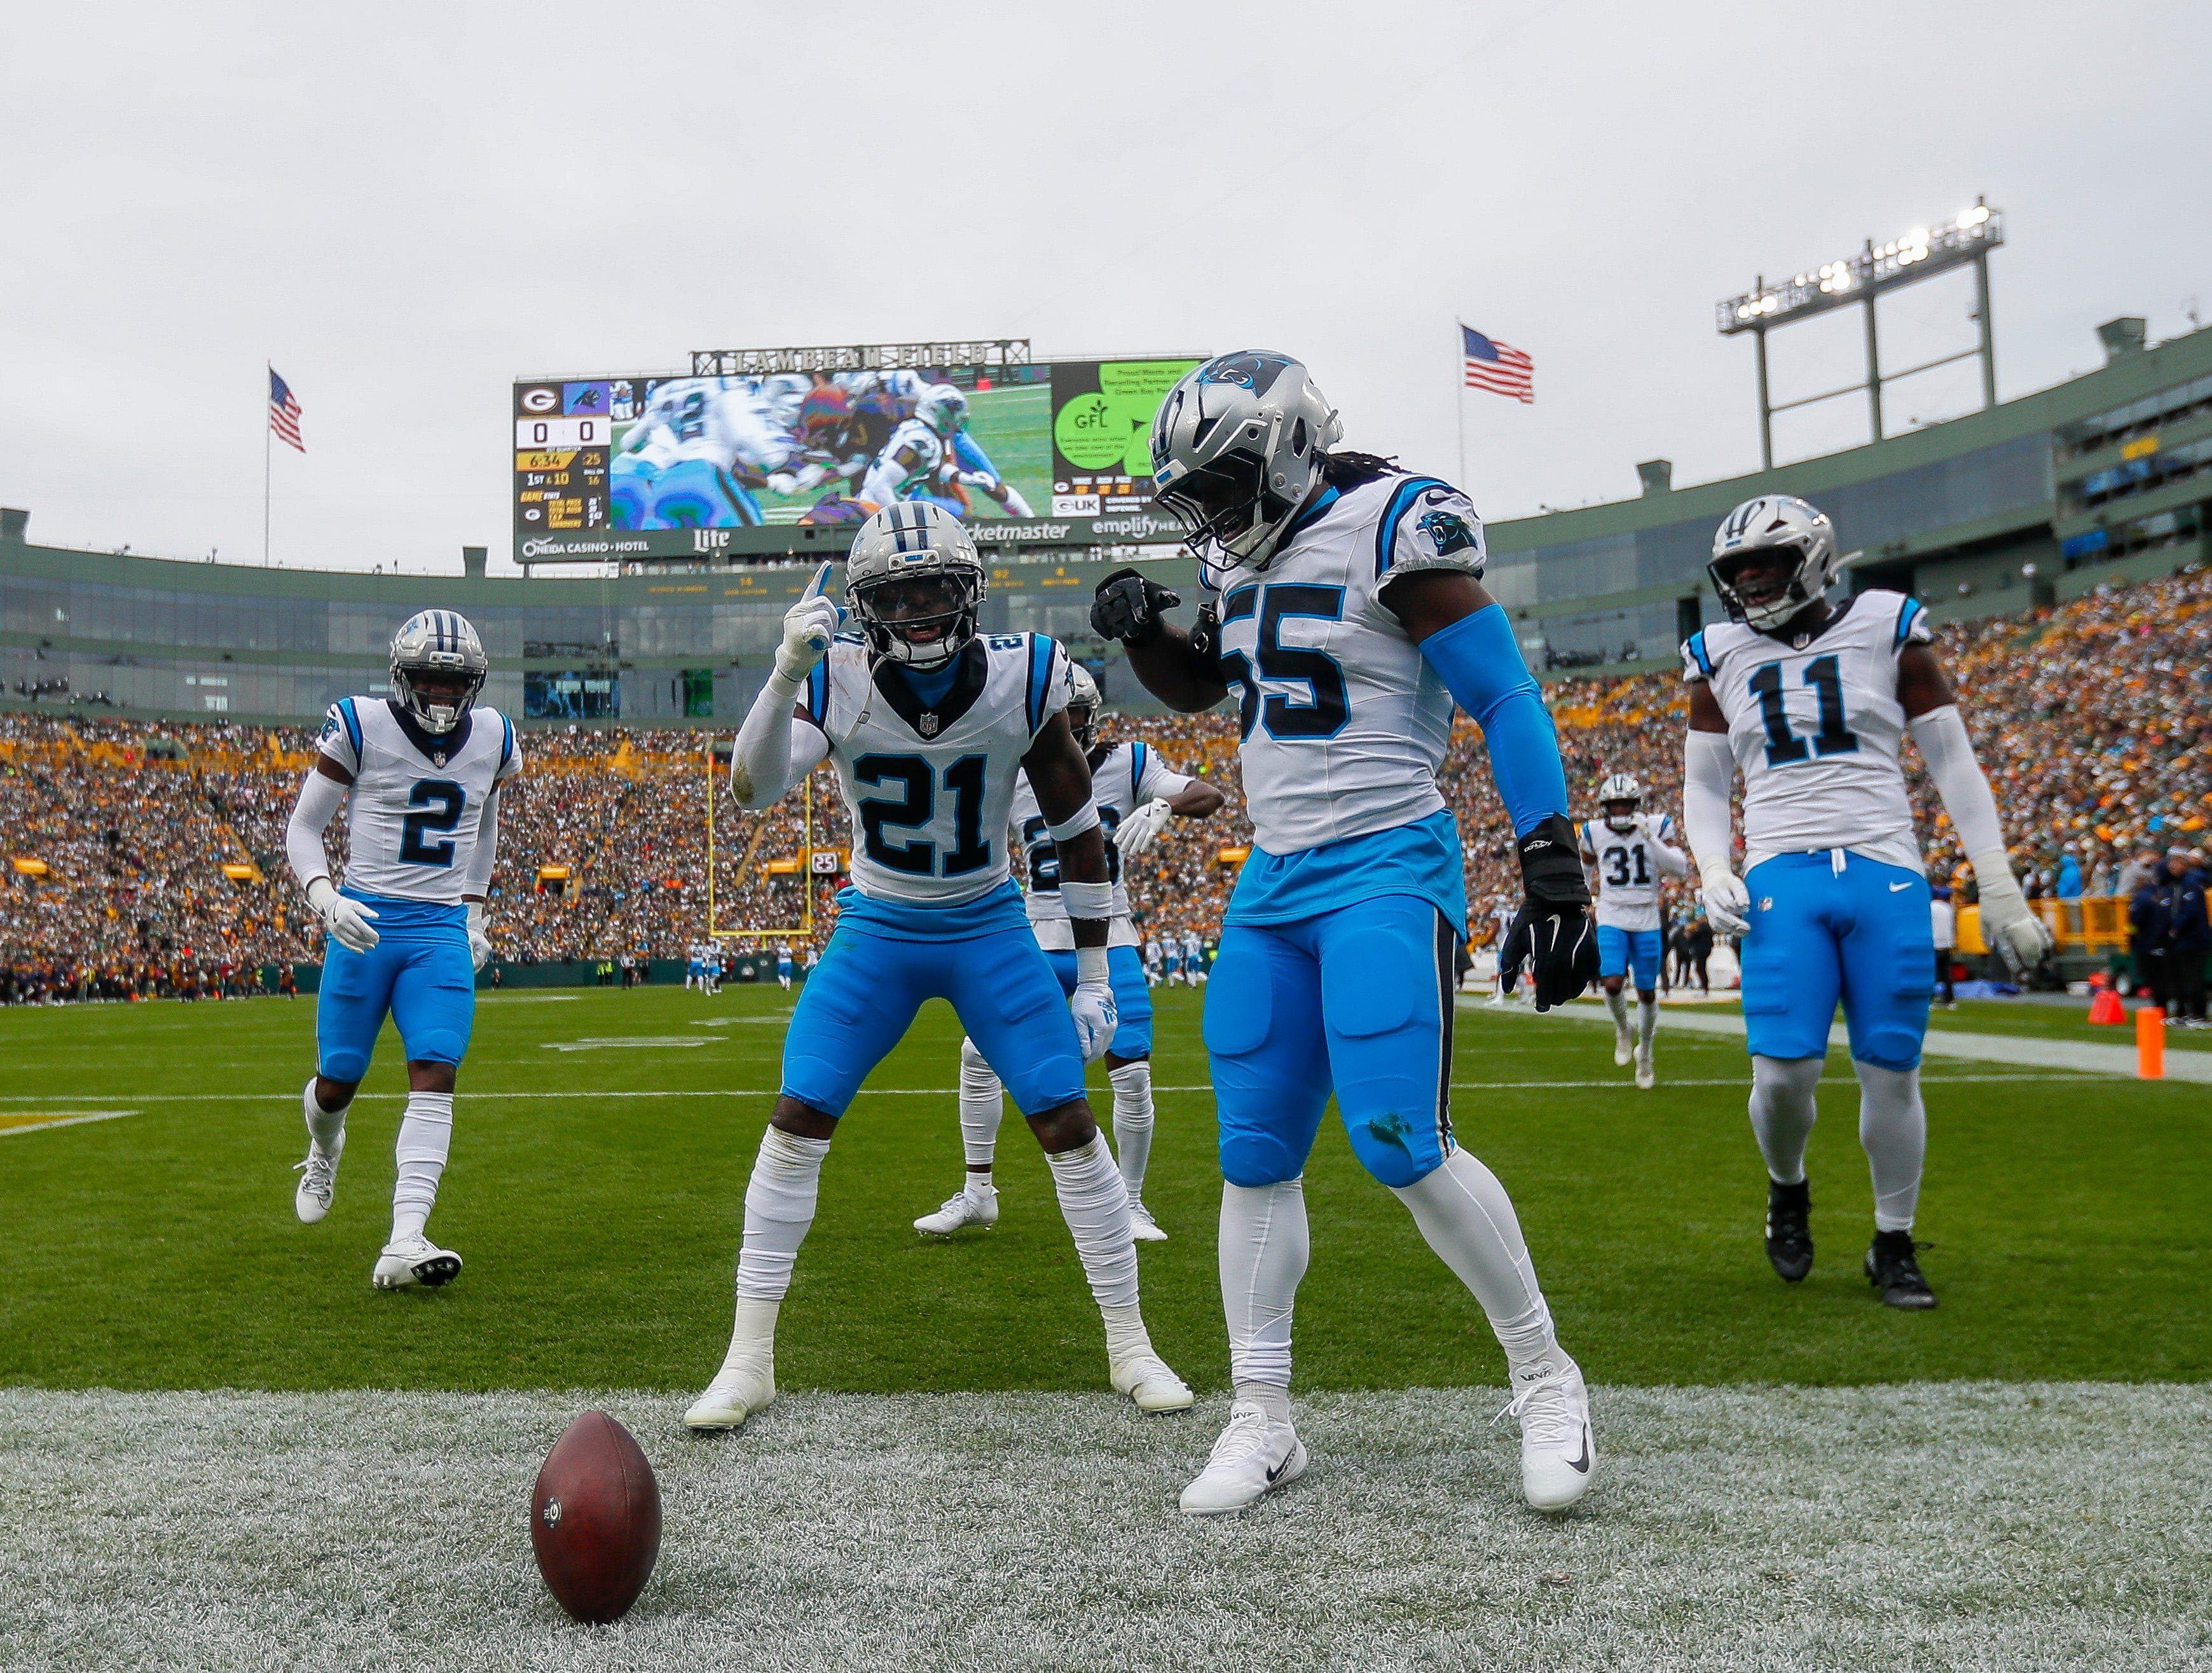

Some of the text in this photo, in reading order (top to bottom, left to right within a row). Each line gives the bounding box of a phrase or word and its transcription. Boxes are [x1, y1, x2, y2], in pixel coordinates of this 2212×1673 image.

[736, 344, 987, 373] LAMBEAU FIELD
[1075, 410, 1109, 429] GFL
[534, 421, 593, 443] 0 0
[530, 454, 561, 467] 6:34
[526, 472, 545, 486] 1ST
[554, 471, 570, 486] 10
[1075, 500, 1097, 511] UK
[1092, 515, 1158, 539] emplify
[522, 540, 566, 558] ONEIDA
[693, 528, 731, 553] Lite
[1219, 582, 1352, 744] 55
[1747, 654, 1860, 769] 11
[398, 779, 467, 868] 2
[852, 752, 991, 878] 21
[816, 857, 834, 869] 25
[1603, 844, 1651, 886] 31
